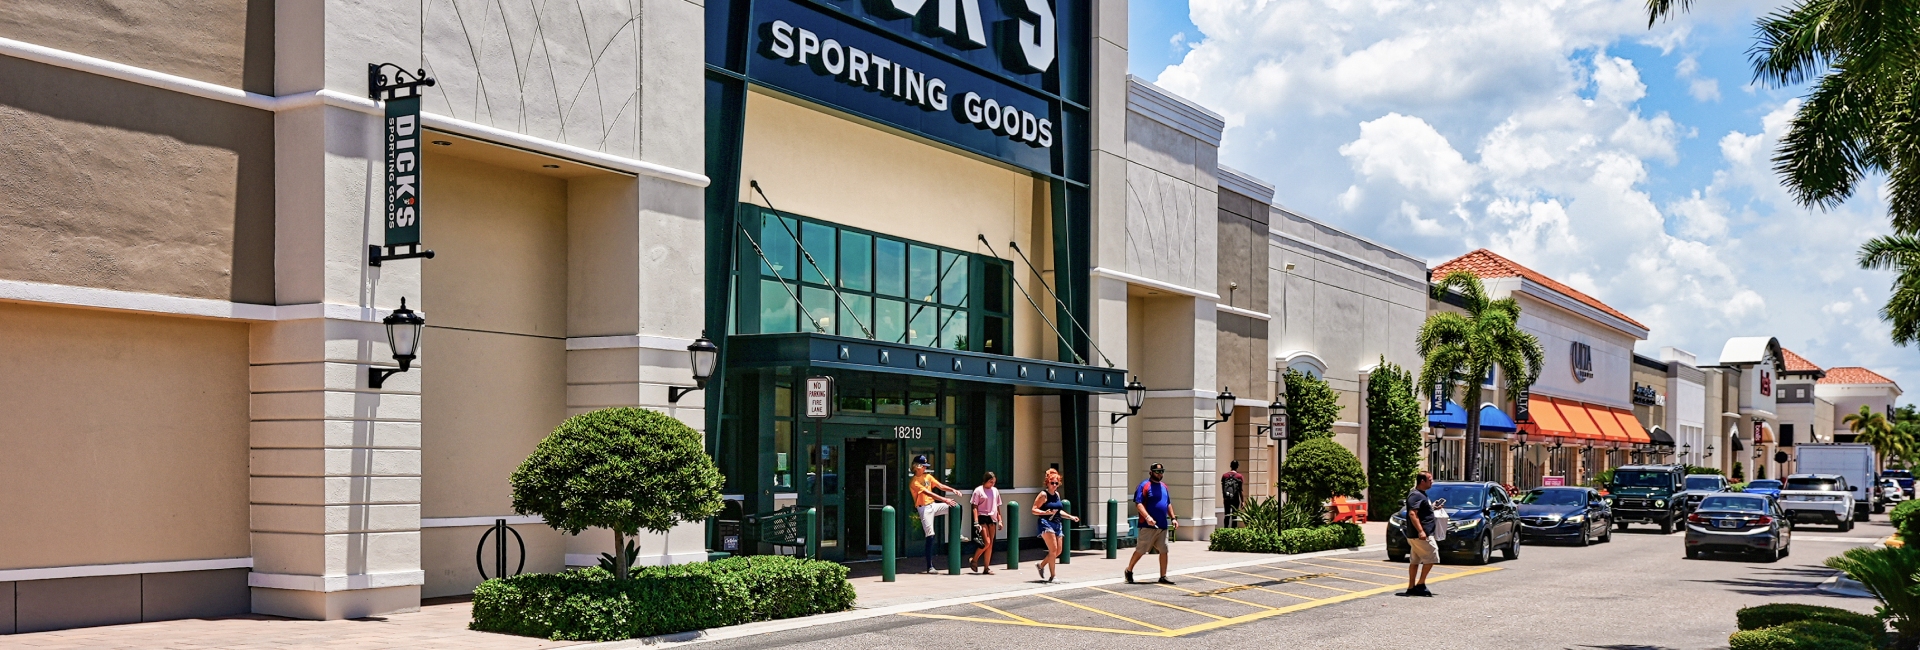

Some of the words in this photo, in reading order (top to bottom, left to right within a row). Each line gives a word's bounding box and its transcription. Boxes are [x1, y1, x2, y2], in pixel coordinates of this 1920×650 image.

[770, 19, 948, 111] SPORTING
[964, 91, 1053, 148] GOODS
[396, 114, 415, 228] DICK'S
[893, 425, 921, 439] 18219
[1519, 390, 1528, 414] ULTA
